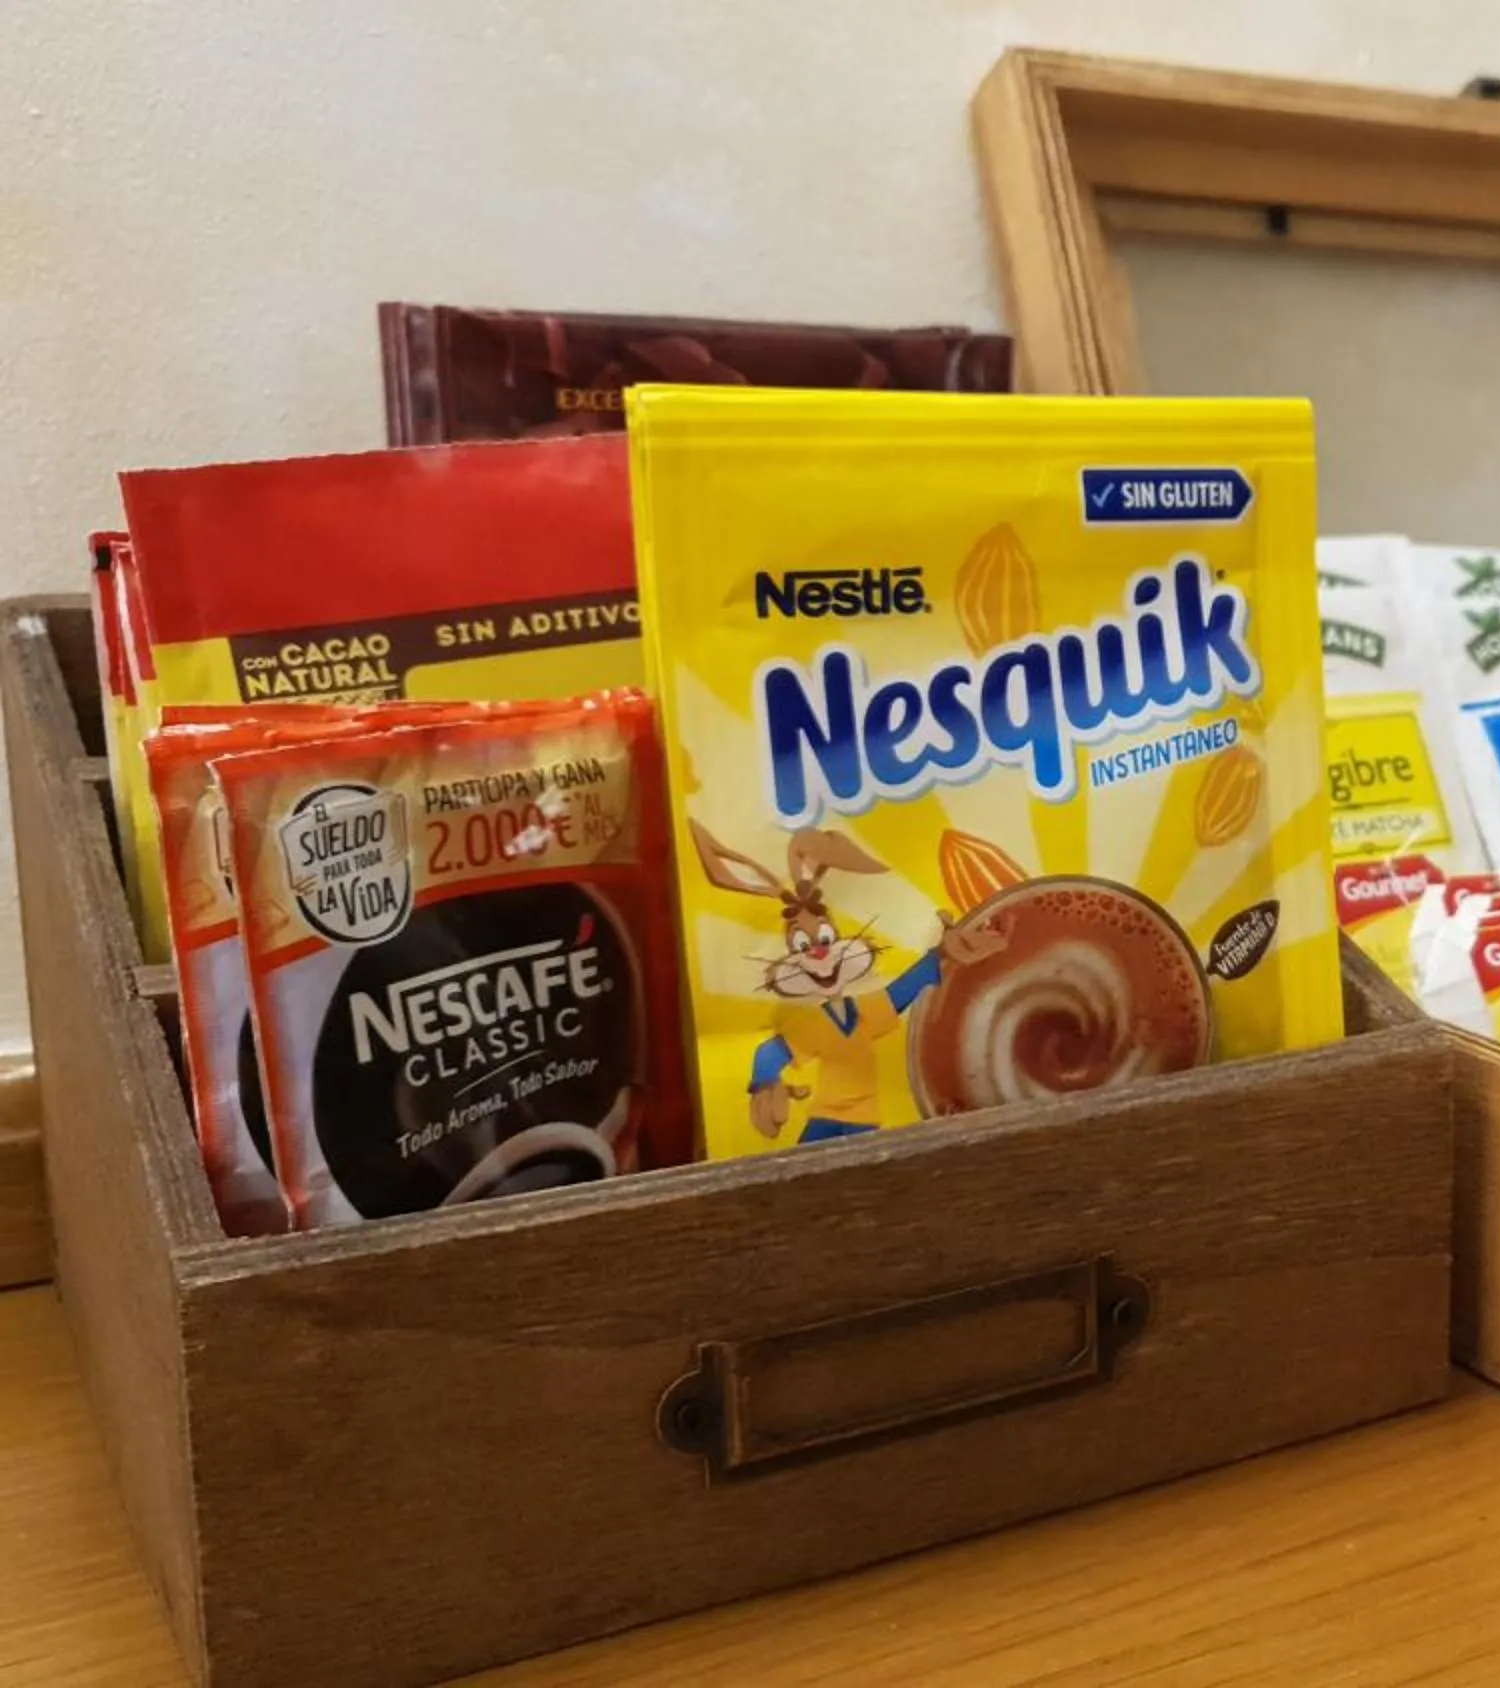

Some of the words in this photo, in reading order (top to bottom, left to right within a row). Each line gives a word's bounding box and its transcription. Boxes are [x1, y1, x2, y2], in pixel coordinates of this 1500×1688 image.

[1121, 482, 1155, 508] SIN
[1160, 481, 1234, 508] GLUTEN
[242, 655, 277, 671] CON
[280, 633, 390, 667] CACAO
[436, 620, 496, 647] SIN
[245, 658, 397, 698] NATURAL
[763, 558, 1253, 817] Nesquik
[423, 771, 531, 814] PARTICIPA
[535, 767, 546, 791] Y
[552, 757, 606, 790] GANA
[300, 809, 386, 867] SUELDO
[317, 886, 338, 915] LA
[350, 914, 603, 1063] NESCAFÉ
[405, 1007, 583, 1087] CLASSIC
[396, 1122, 444, 1159] Todo
[509, 1073, 543, 1101] Todo
[544, 1057, 599, 1086] Sabor
